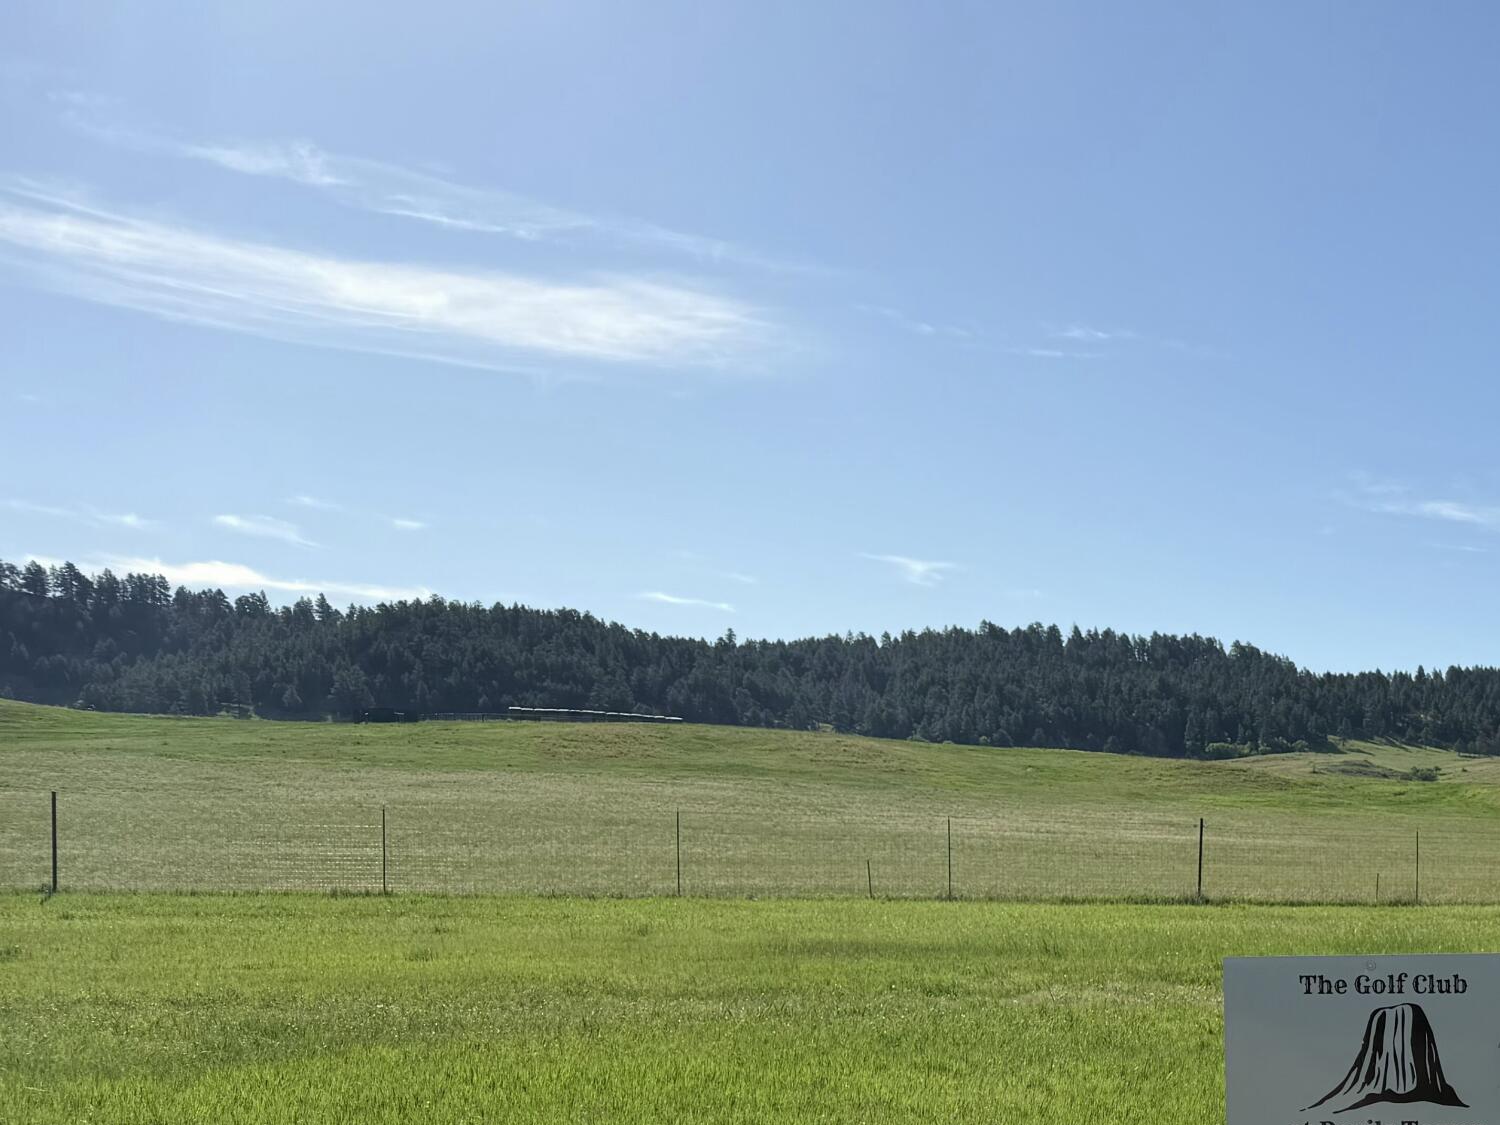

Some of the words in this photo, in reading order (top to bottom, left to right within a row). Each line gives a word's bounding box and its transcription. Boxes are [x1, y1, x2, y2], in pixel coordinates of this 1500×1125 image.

[1299, 975, 1347, 994] The
[1355, 973, 1408, 994] Golf
[1413, 974, 1467, 994] Club
